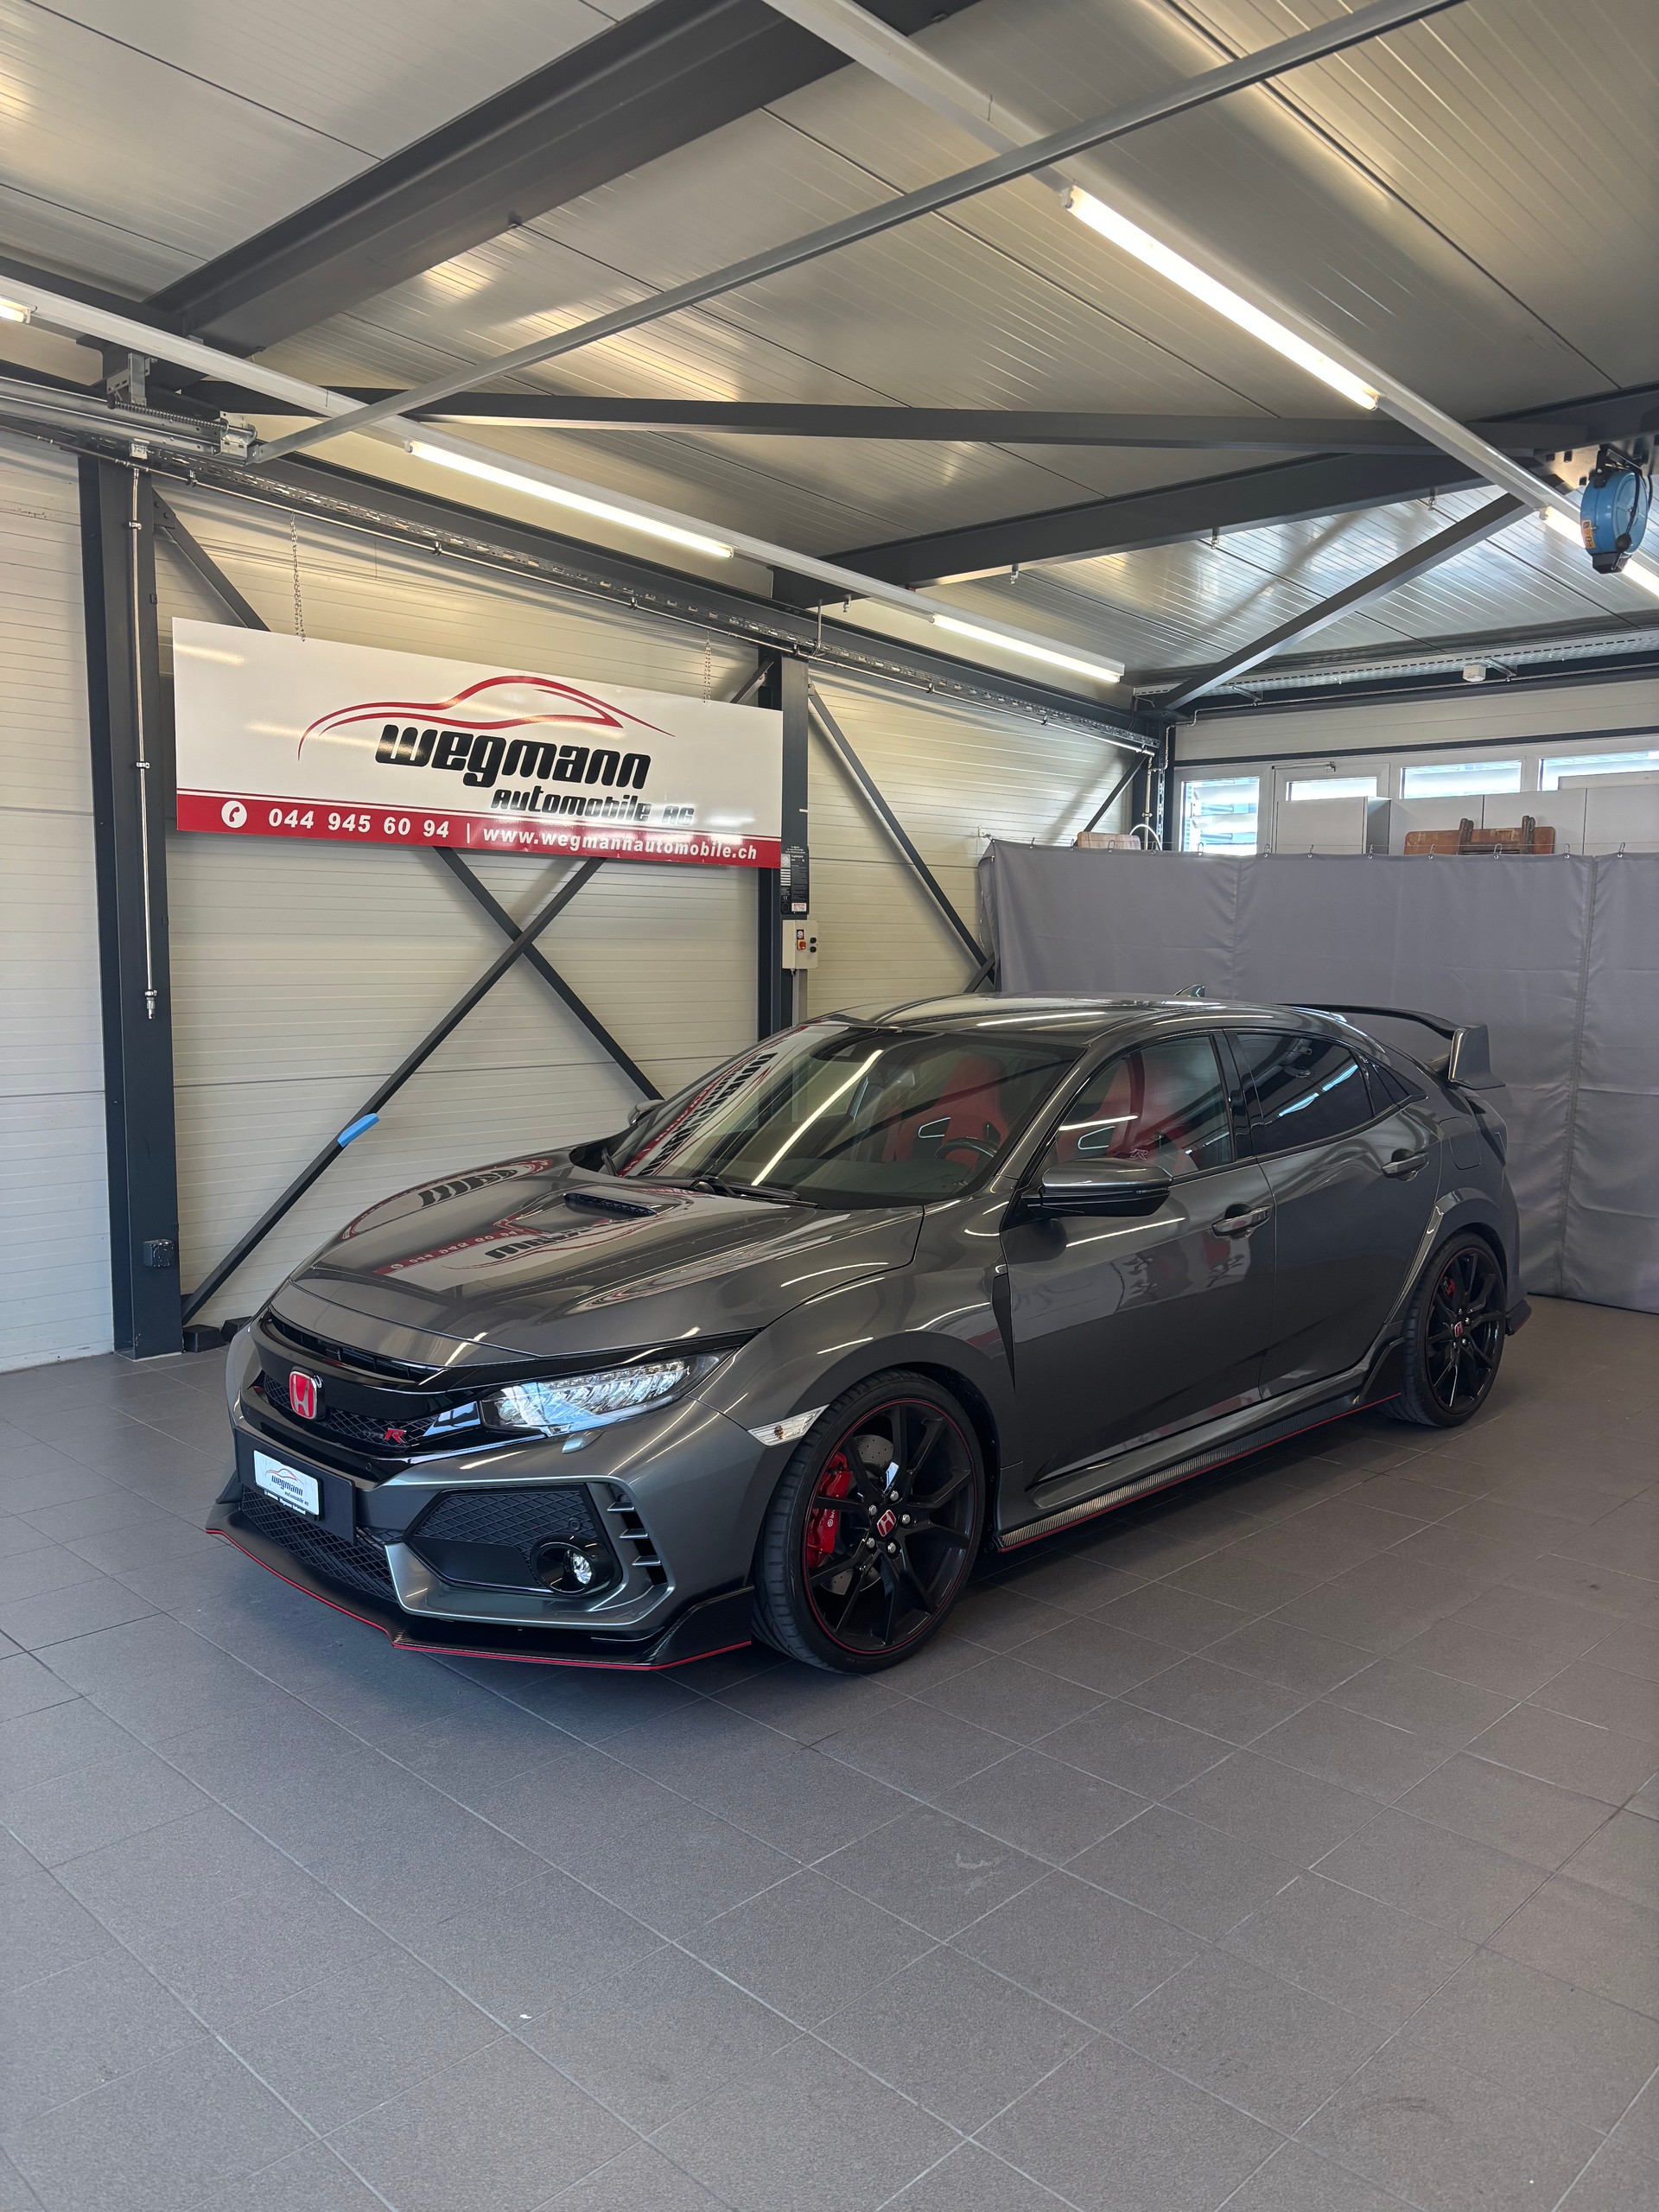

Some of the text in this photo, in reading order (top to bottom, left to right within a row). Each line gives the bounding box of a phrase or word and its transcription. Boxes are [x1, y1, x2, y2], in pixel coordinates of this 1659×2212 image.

[375, 724, 651, 790] wegmann
[268, 808, 758, 861] 044 945 60 94 www.wegmannautomobile.ch
[270, 1475, 303, 1497] wegmann
